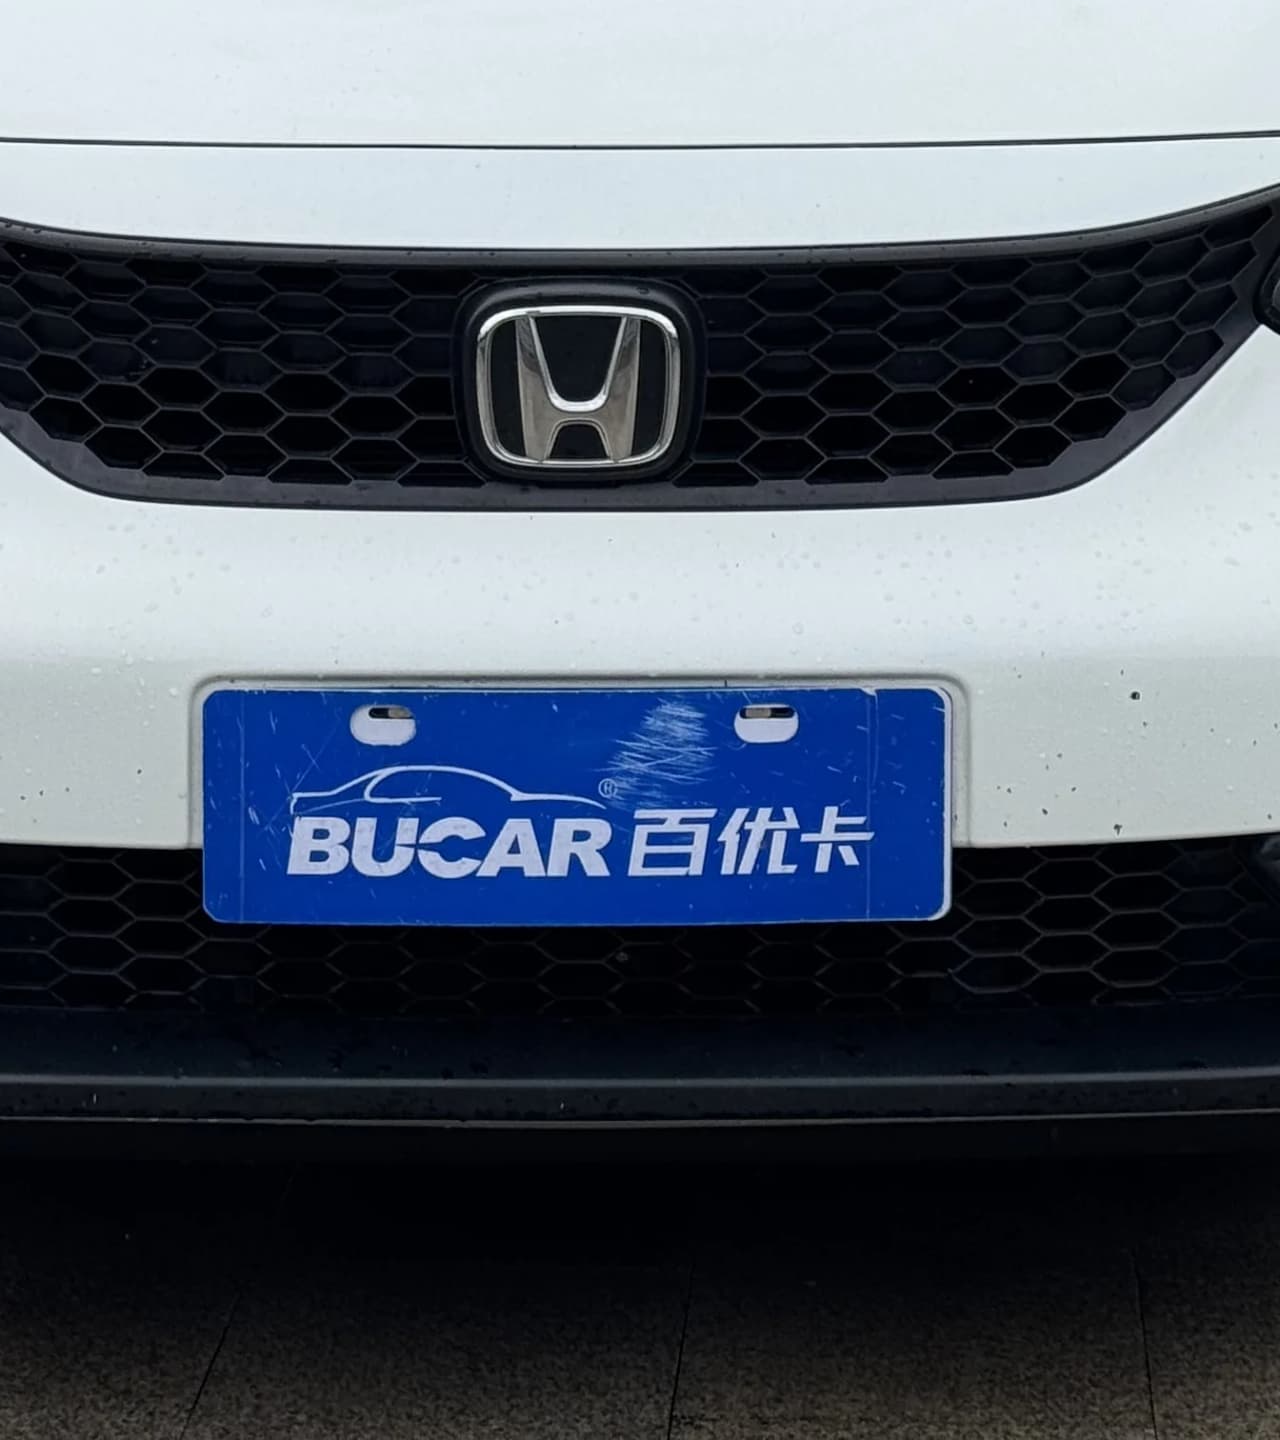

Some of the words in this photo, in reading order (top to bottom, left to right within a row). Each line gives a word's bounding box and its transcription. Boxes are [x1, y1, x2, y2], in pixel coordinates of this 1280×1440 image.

[286, 816, 614, 878] BUCAR
[628, 807, 876, 876] 百优卡
